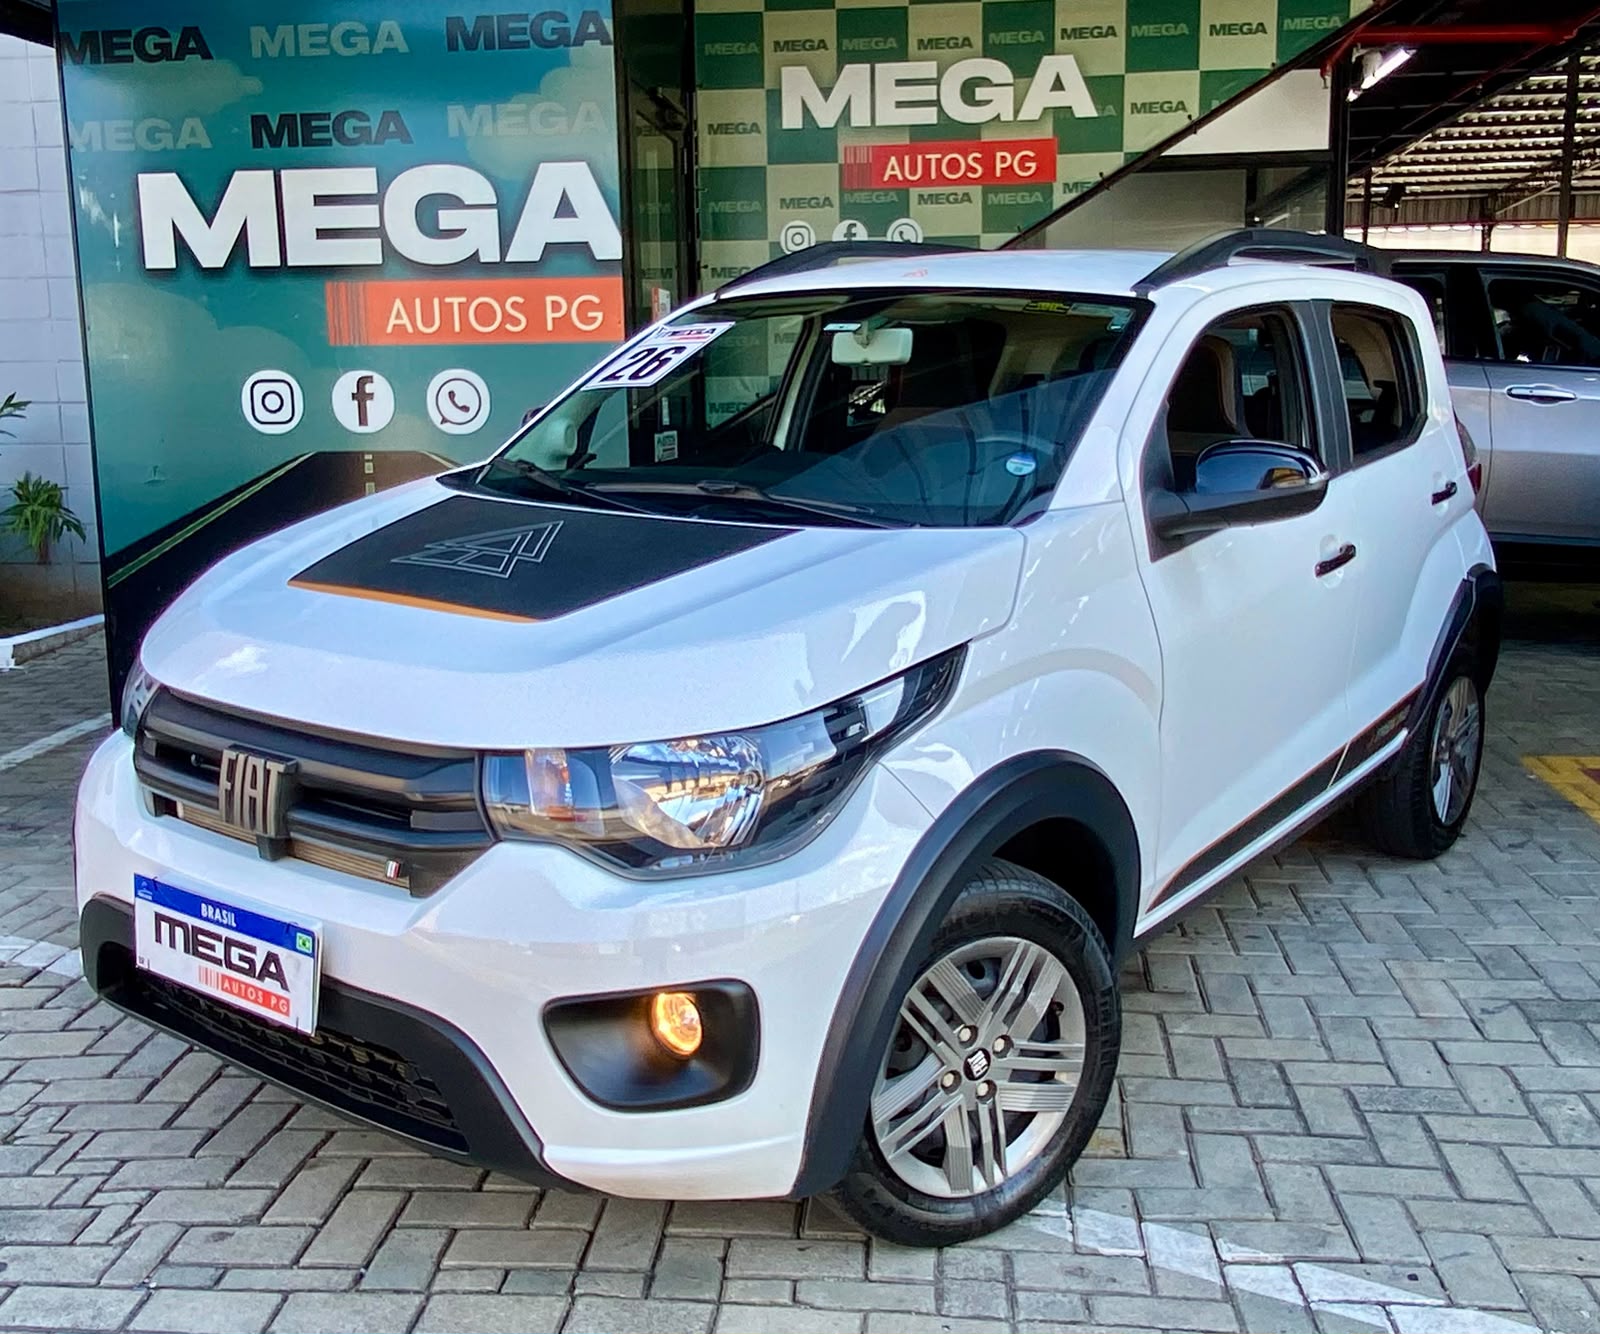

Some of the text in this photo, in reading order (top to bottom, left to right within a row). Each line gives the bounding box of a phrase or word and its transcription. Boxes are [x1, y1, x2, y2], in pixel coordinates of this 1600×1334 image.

[446, 10, 613, 51] MEGA
[1131, 23, 1189, 38] MEGA
[1209, 22, 1267, 37] MEGA
[1284, 16, 1342, 31] MEGA
[250, 20, 409, 58] MEGA
[988, 31, 1045, 45] MEGA
[1060, 25, 1118, 40] MEGA
[60, 26, 214, 65] MEGA
[704, 42, 760, 55] MEGA
[773, 39, 829, 52] MEGA
[842, 37, 897, 50] MEGA
[917, 37, 973, 50] MEGA
[781, 55, 1098, 129] MEGA
[1130, 101, 1187, 115] MEGA
[447, 102, 610, 138] MEGA
[70, 117, 213, 152] MEGA
[250, 110, 414, 149] MEGA
[707, 121, 761, 135] MEGA
[883, 151, 1037, 181] AUTOS PG
[1062, 181, 1099, 194] ME
[780, 197, 834, 209] MEGA
[844, 190, 899, 204] MEGA
[917, 192, 973, 206] MEGA
[988, 191, 1043, 206] MEGA
[709, 201, 762, 213] MEGA
[138, 161, 623, 269] MEGA
[711, 267, 751, 279] MEG
[386, 294, 604, 334] AUTOS PG
[774, 332, 797, 344] ME
[600, 346, 687, 381] 26
[709, 402, 746, 414] MEG
[219, 749, 286, 835] FIAT
[200, 903, 237, 928] BRASIL
[154, 911, 290, 993] MEGA
[223, 978, 288, 1013] AUTOS PG
